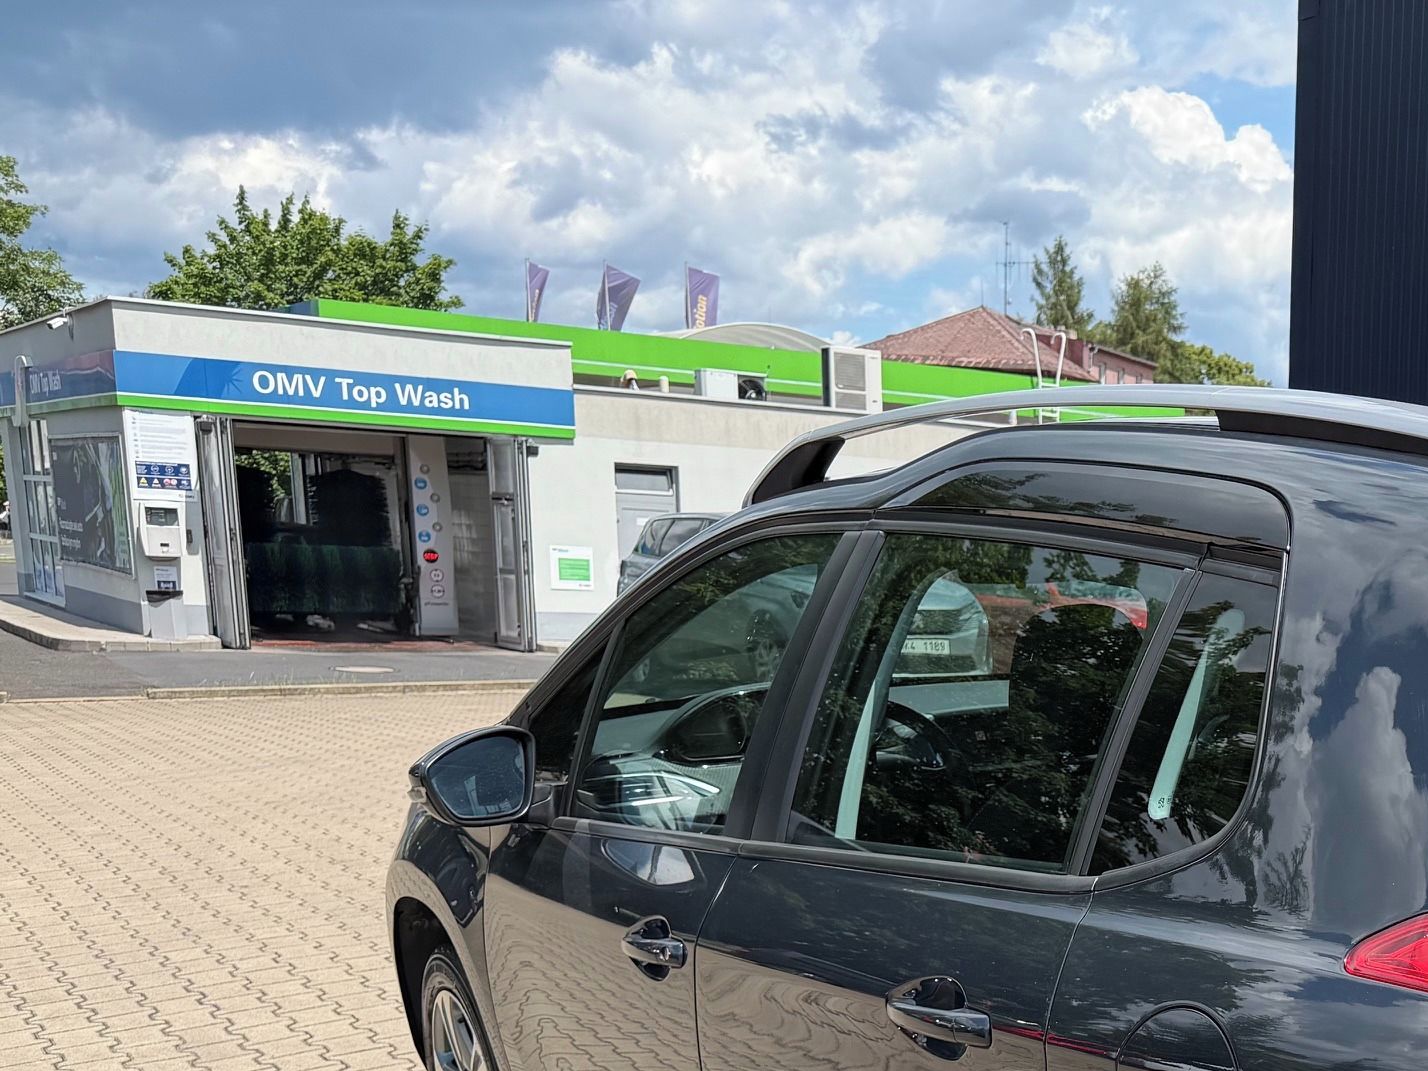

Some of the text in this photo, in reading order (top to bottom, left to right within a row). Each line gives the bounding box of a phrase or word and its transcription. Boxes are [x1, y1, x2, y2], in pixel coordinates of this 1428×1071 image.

[252, 370, 470, 410] OMV Top Wash
